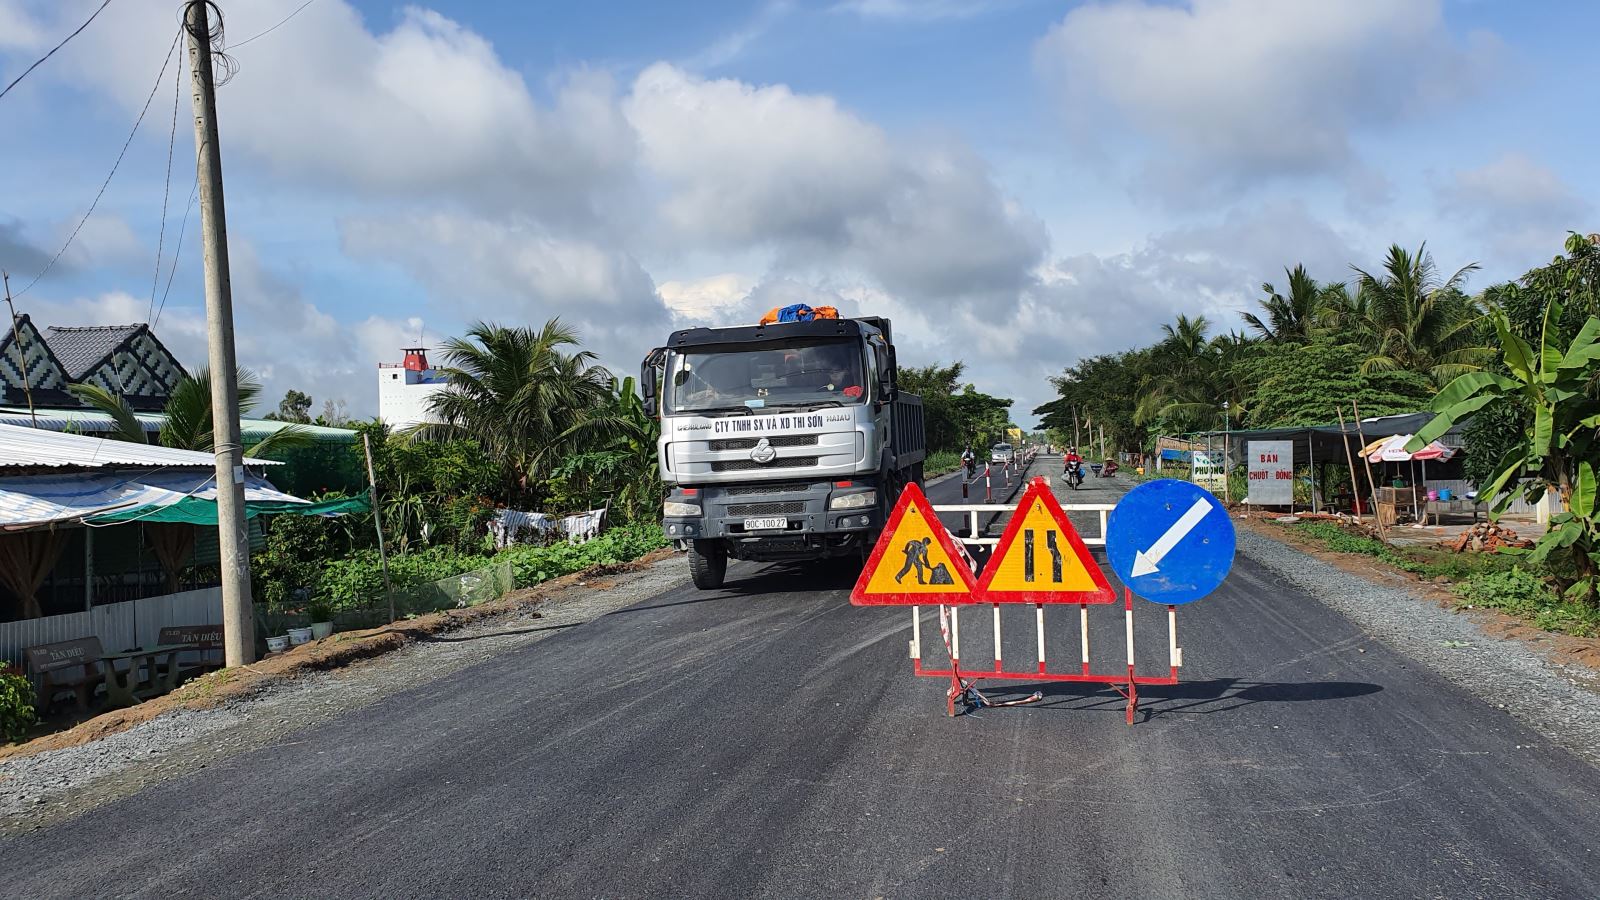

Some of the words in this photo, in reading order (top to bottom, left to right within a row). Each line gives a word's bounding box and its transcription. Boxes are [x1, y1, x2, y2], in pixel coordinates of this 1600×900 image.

[715, 421, 729, 433] CTY
[732, 420, 751, 432] TNHH
[753, 419, 764, 431] SX
[793, 416, 805, 429] THI
